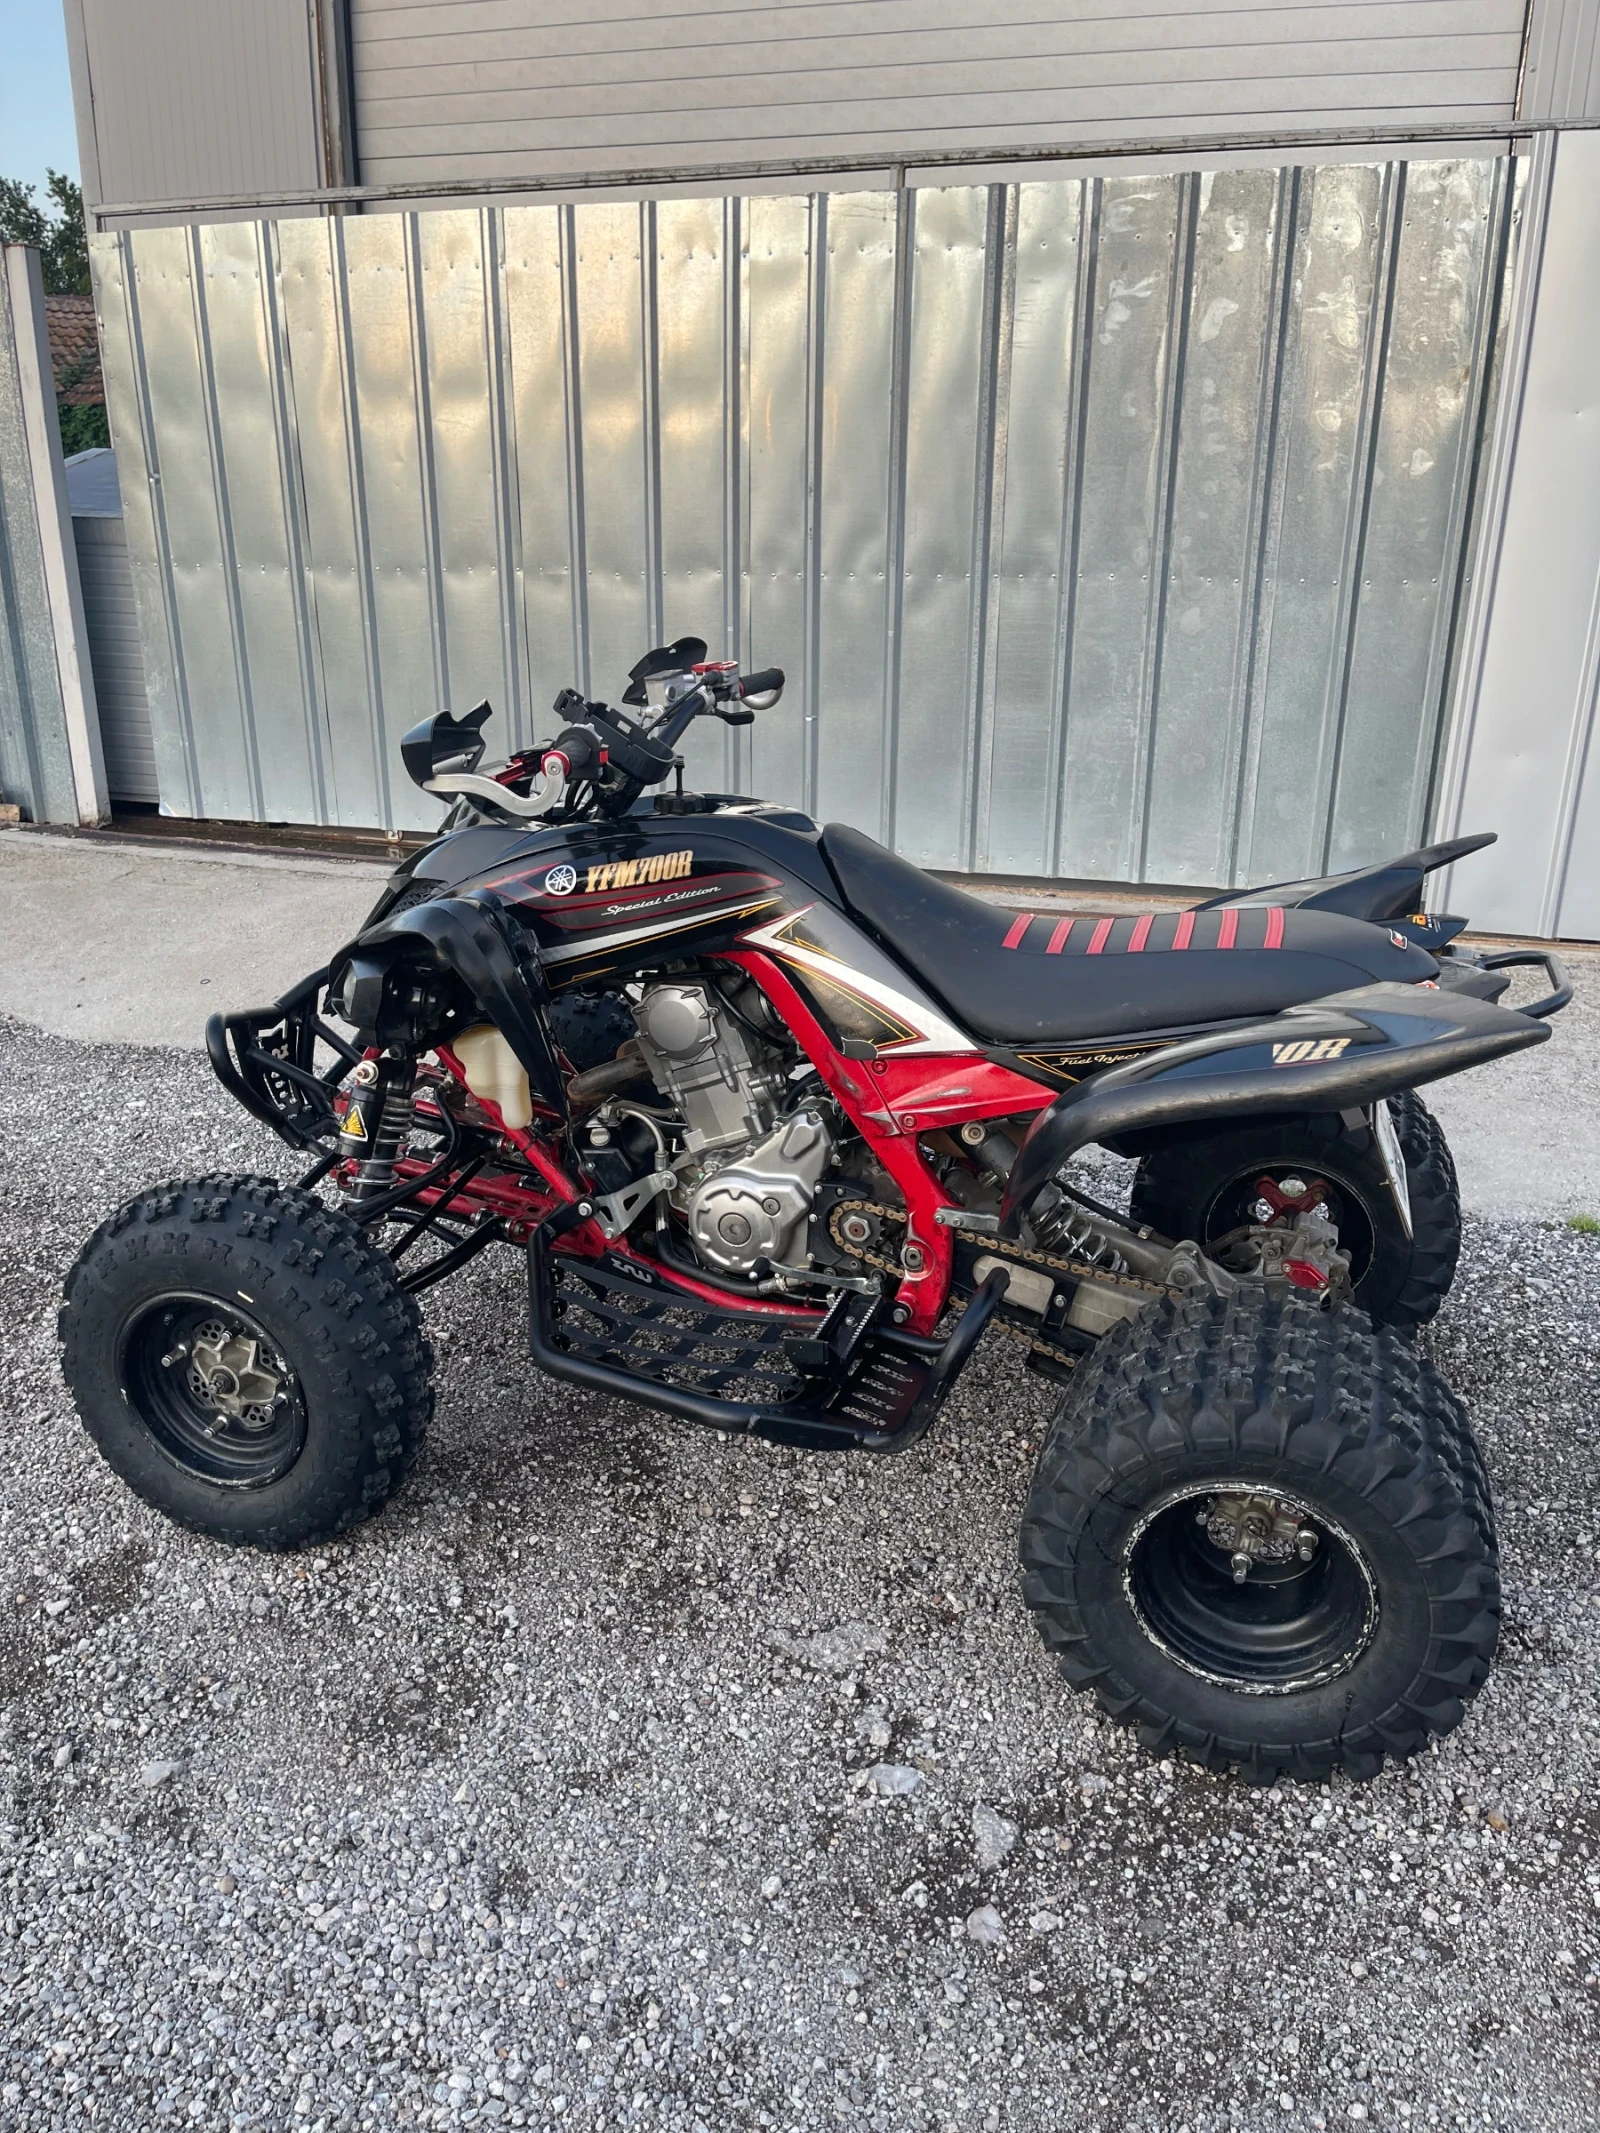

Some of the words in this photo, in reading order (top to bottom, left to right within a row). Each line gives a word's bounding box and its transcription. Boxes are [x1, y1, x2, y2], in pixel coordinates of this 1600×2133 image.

[585, 850, 694, 893] YFM700R
[601, 898, 662, 916] Special
[663, 886, 722, 903] Edition
[1051, 1056, 1093, 1067] Fuel
